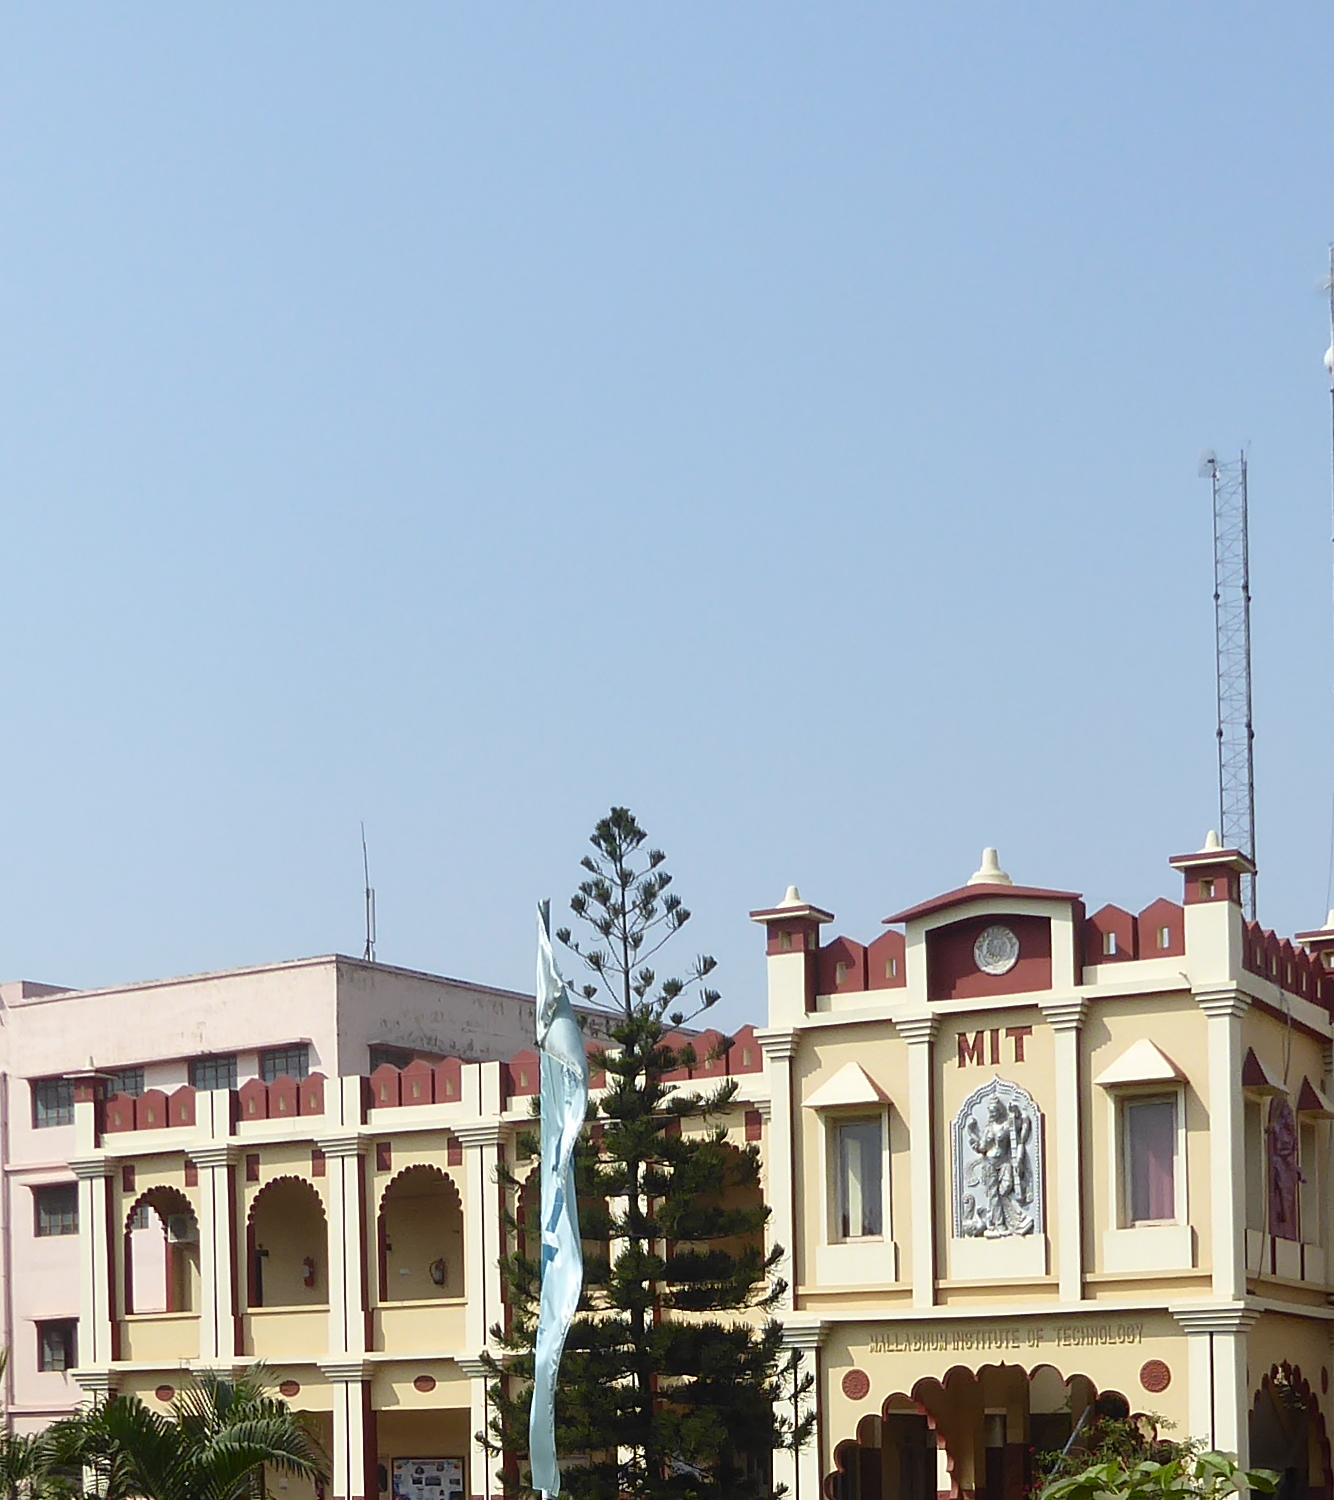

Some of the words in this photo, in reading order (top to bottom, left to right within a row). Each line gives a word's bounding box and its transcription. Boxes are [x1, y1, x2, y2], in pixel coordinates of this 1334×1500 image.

[956, 1025, 1033, 1068] MIT
[869, 1332, 947, 1353] MALLABHUM
[952, 1328, 1021, 1351] INSTITUTE
[1026, 1327, 1044, 1348] OF
[1054, 1322, 1144, 1347] TECHNOLOGY
